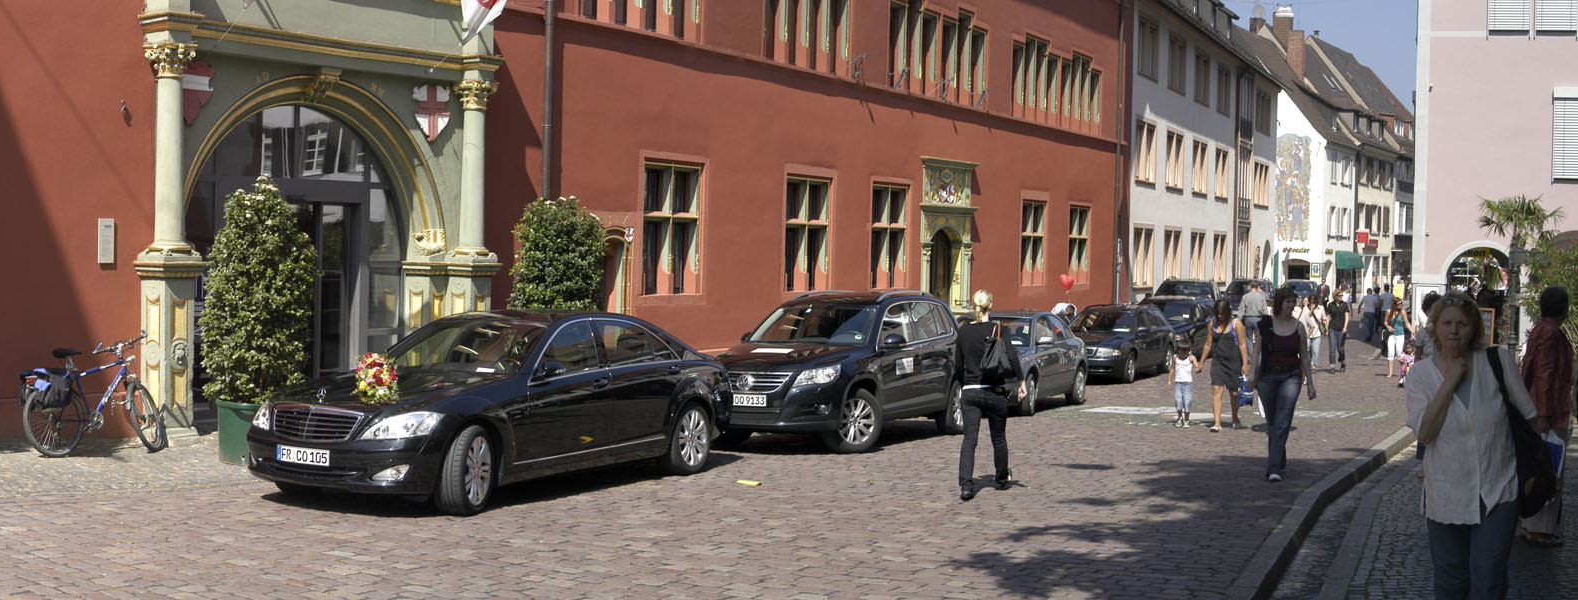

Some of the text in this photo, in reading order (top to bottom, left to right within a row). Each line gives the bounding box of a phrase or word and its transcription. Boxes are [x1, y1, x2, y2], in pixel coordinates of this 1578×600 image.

[746, 396, 765, 405] 9133
[281, 448, 292, 460] FR
[309, 452, 328, 464] 105
